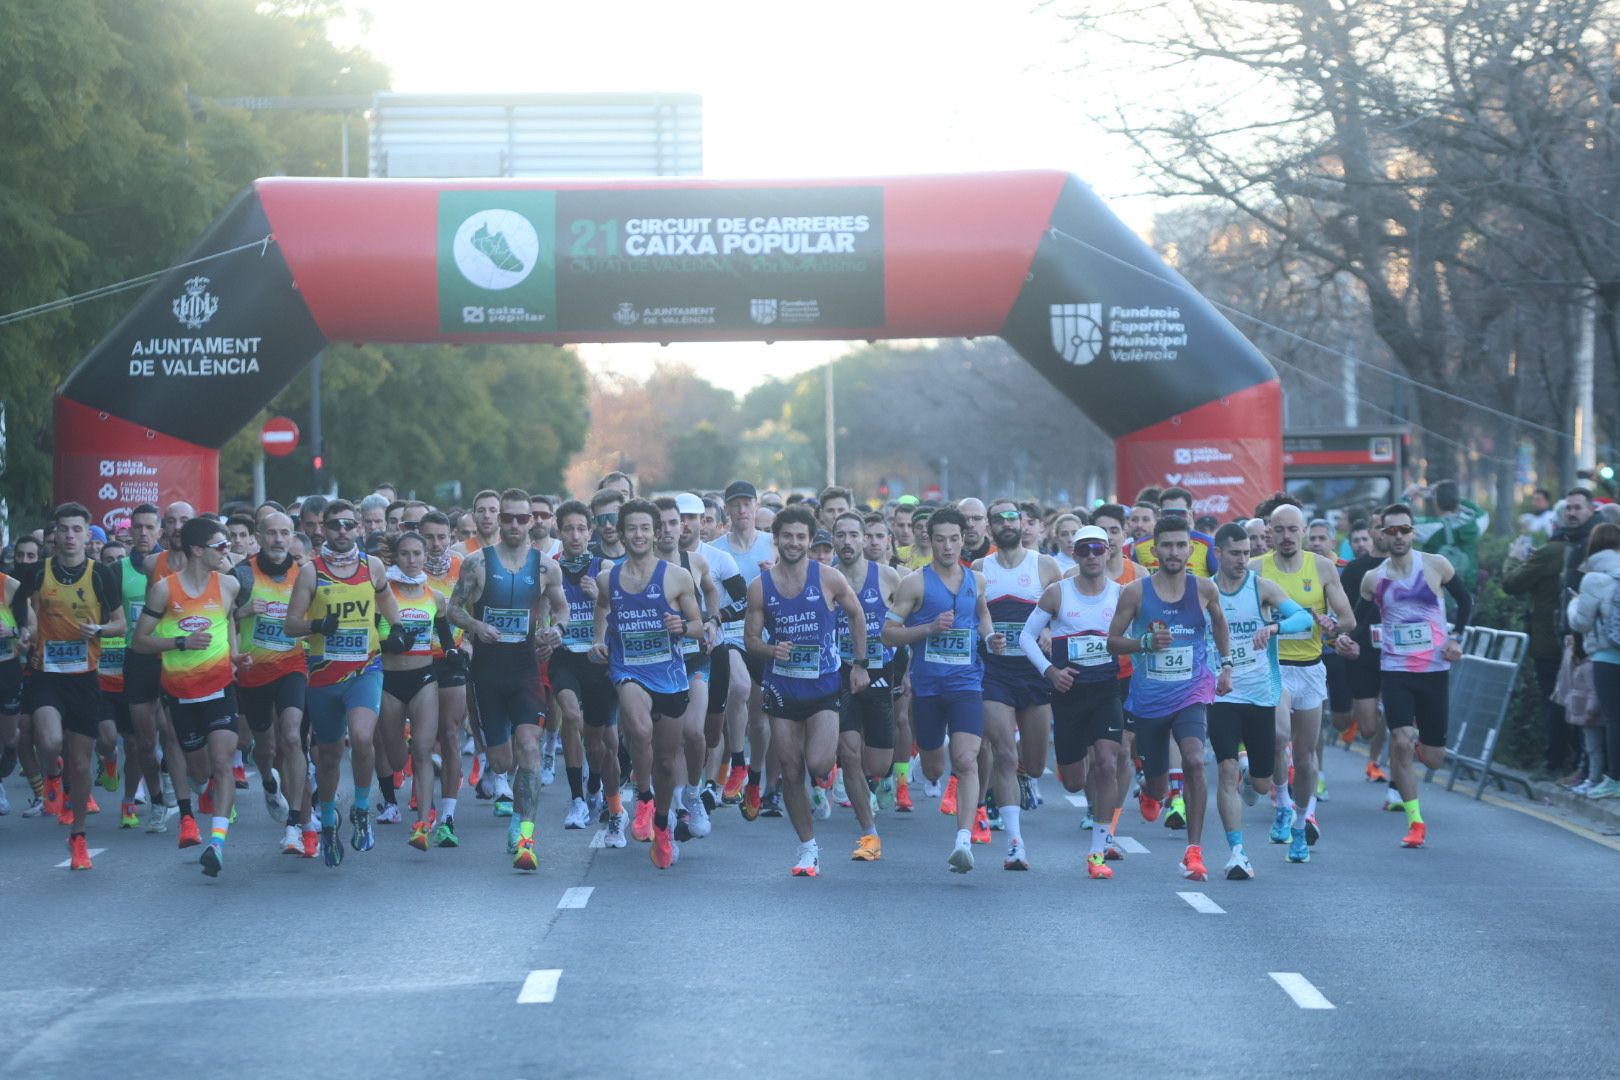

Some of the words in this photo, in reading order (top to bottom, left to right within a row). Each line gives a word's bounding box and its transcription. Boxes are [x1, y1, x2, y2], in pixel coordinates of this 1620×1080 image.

[625, 218, 712, 234] CIRCUIT
[717, 218, 746, 233] DE
[748, 216, 870, 233] CARRERES
[570, 219, 618, 255] 21
[625, 234, 718, 256] CAIXA
[723, 233, 856, 254] POPULAR
[487, 306, 525, 314] caixa
[643, 307, 716, 316] AJUNTAMENT
[1109, 306, 1180, 318] Fundació
[488, 313, 546, 323] popular
[643, 316, 657, 325] DE
[1109, 319, 1185, 335] Esportiva
[131, 336, 262, 357] AJUNTAMENT
[1109, 333, 1188, 350] Municipal
[1110, 348, 1178, 361] València
[129, 359, 155, 376] DE
[163, 355, 260, 376] VALÈNCIA
[117, 466, 158, 476] popular
[120, 487, 159, 495] TRINIDAD
[120, 494, 159, 502] ALFONSO
[326, 600, 370, 619] UPV
[567, 601, 595, 610] BLAT
[617, 609, 658, 619] POBLATS
[775, 611, 817, 624] POBLATS
[838, 612, 876, 624] POTS
[487, 615, 521, 629] 2371
[617, 620, 663, 632] MARÍTIMS
[775, 623, 819, 635] MARÍTIMS
[1408, 629, 1422, 640] 13
[624, 638, 662, 652] 2385
[930, 636, 964, 650] 2175
[1086, 642, 1104, 653] 24
[48, 646, 81, 657] 2441
[1165, 655, 1184, 667] 34
